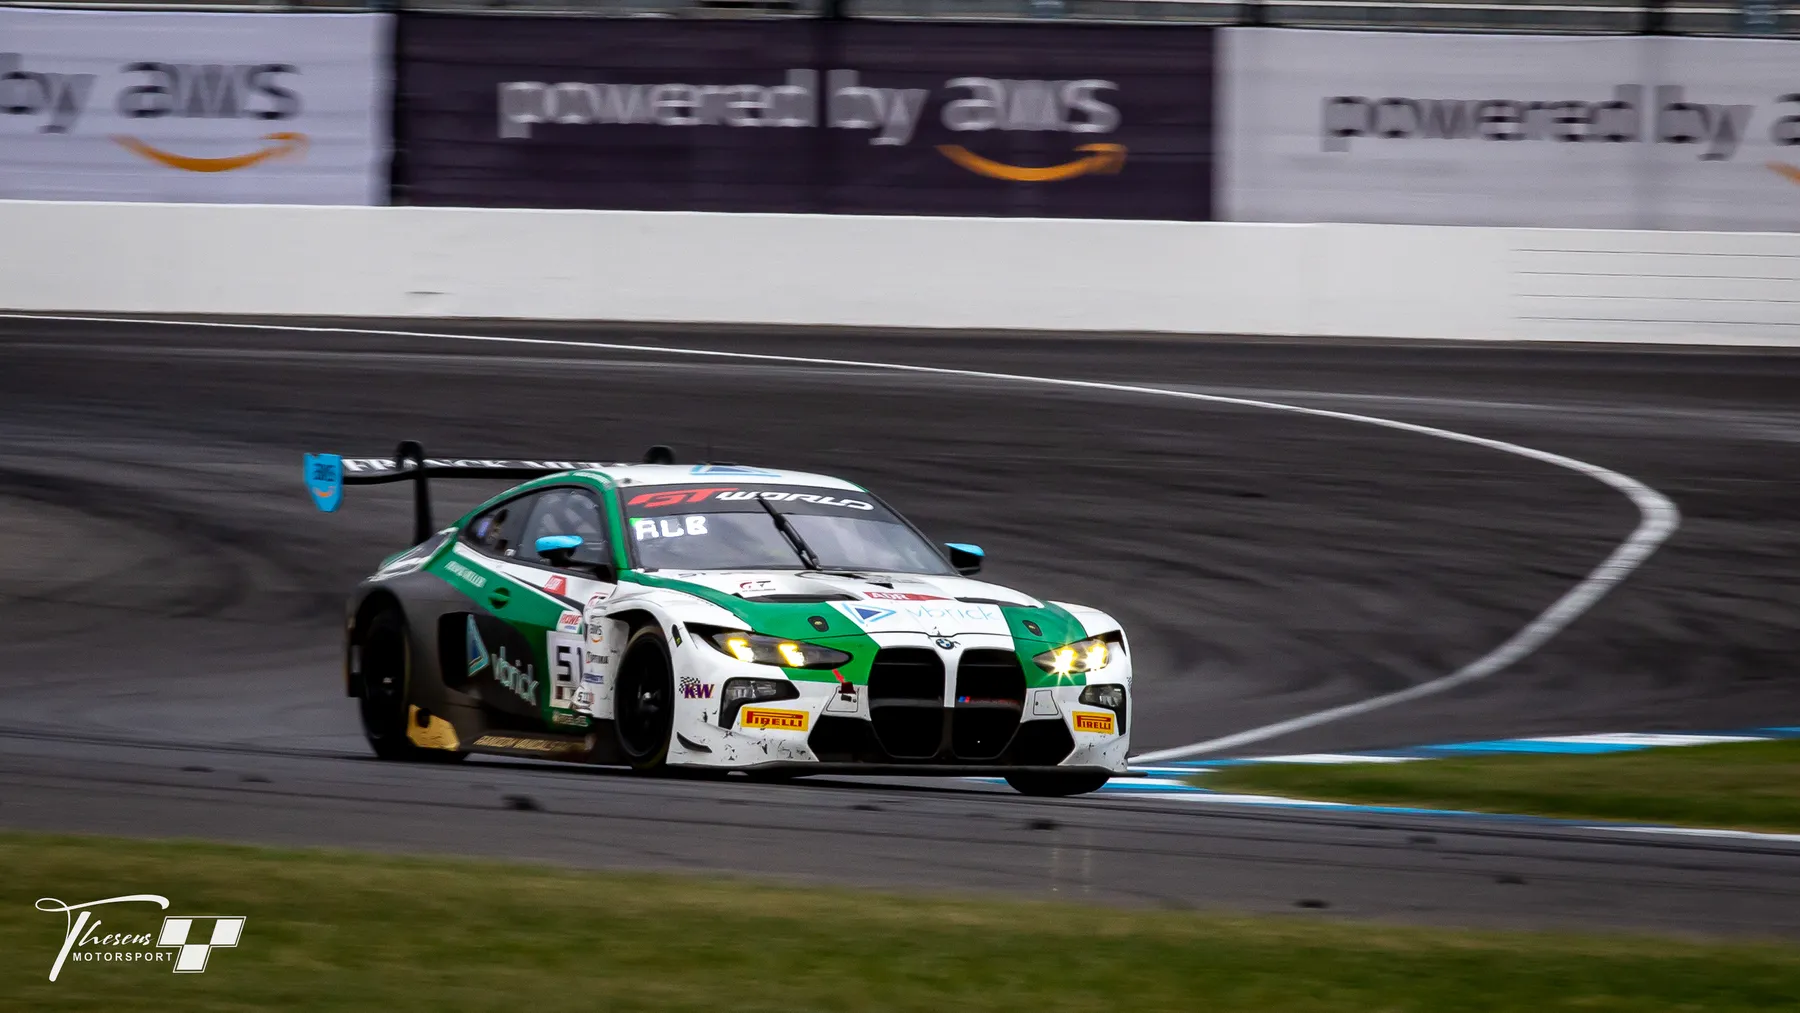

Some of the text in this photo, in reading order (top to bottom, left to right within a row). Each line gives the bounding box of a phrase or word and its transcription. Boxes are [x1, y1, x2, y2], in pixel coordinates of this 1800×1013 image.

[0, 53, 303, 134] by aws
[498, 68, 1122, 146] powered by aws
[1322, 84, 1643, 153] powered
[1654, 84, 1755, 161] by
[683, 683, 715, 699] KW
[746, 710, 804, 728] PIRELLI
[1076, 715, 1111, 730] PIRELLI
